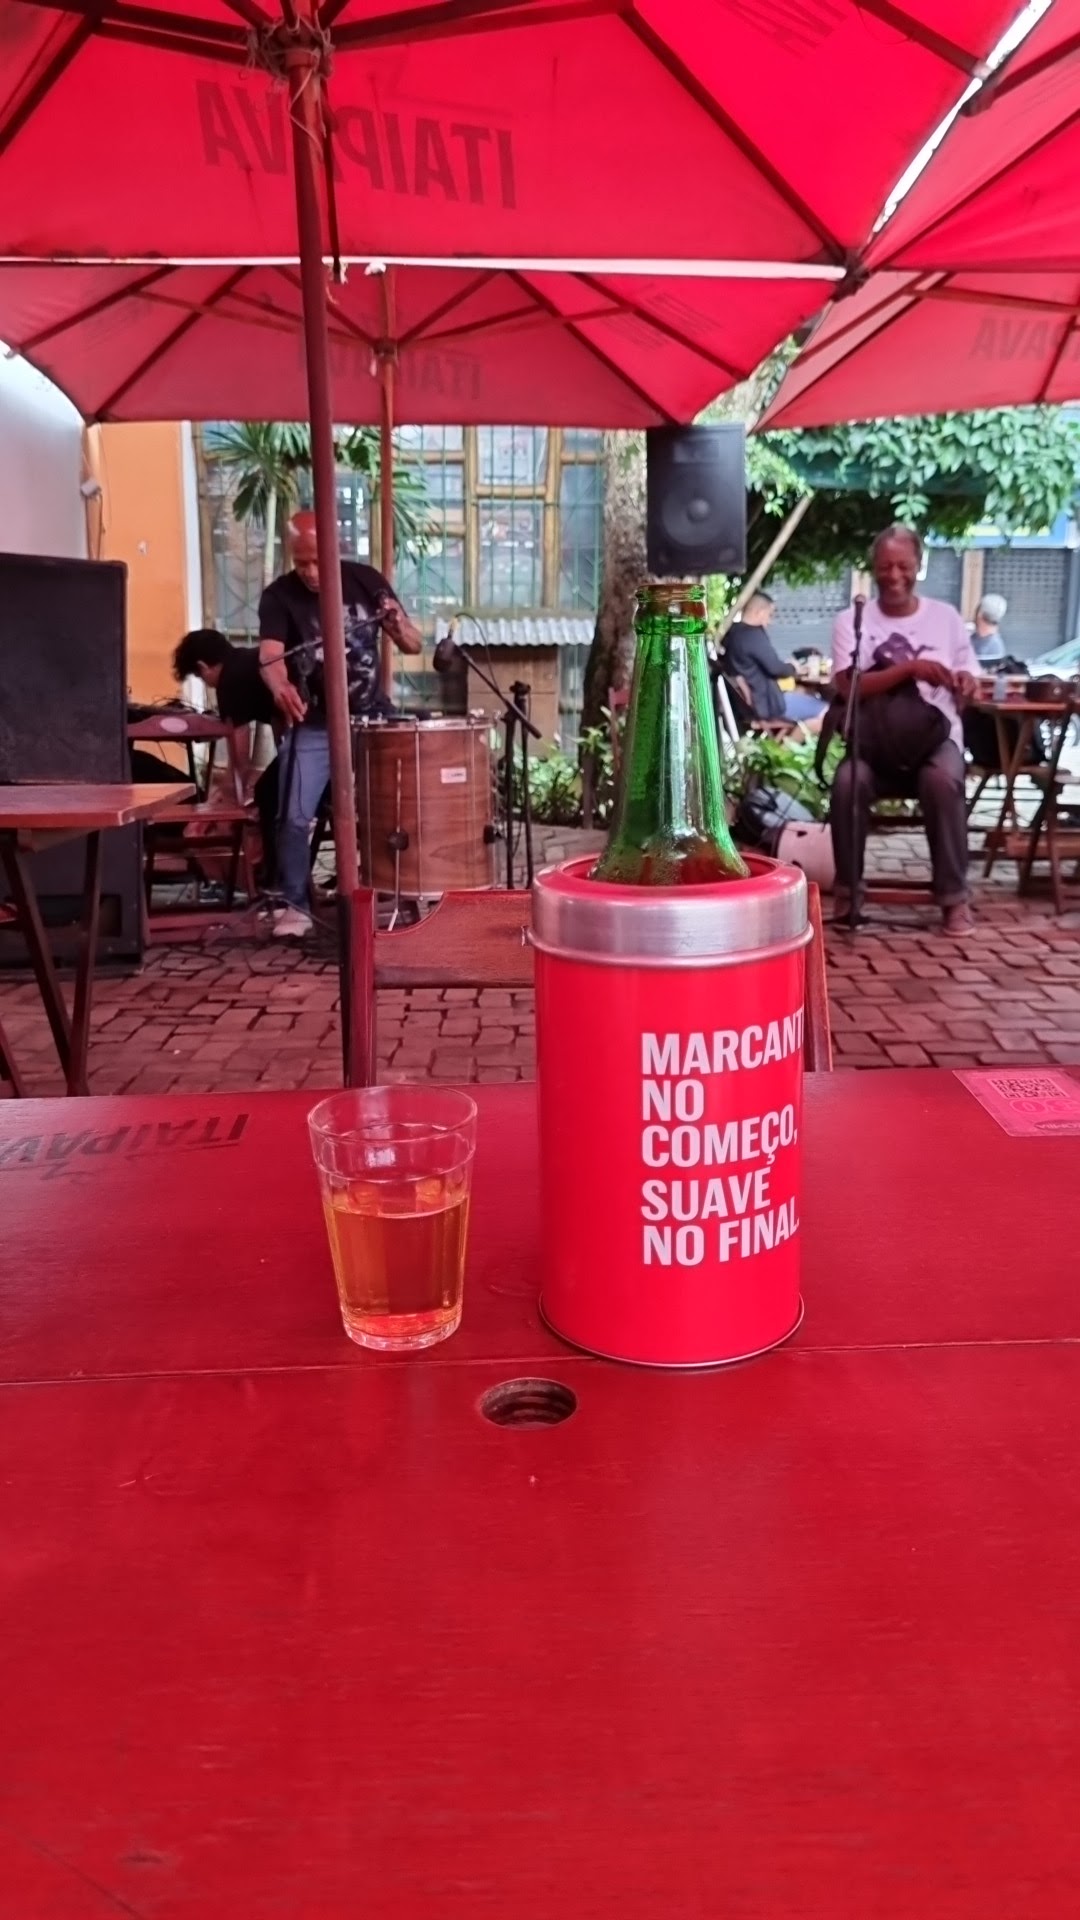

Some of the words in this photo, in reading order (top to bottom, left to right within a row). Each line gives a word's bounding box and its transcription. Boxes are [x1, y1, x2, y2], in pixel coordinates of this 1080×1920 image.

[642, 1079, 705, 1122] NO
[0, 1113, 250, 1165] ITAIPAV
[641, 1103, 798, 1168] COMEÇO,
[641, 1166, 771, 1221] SUAVE
[643, 1225, 705, 1266] NO
[719, 1195, 800, 1263] FINAL.
